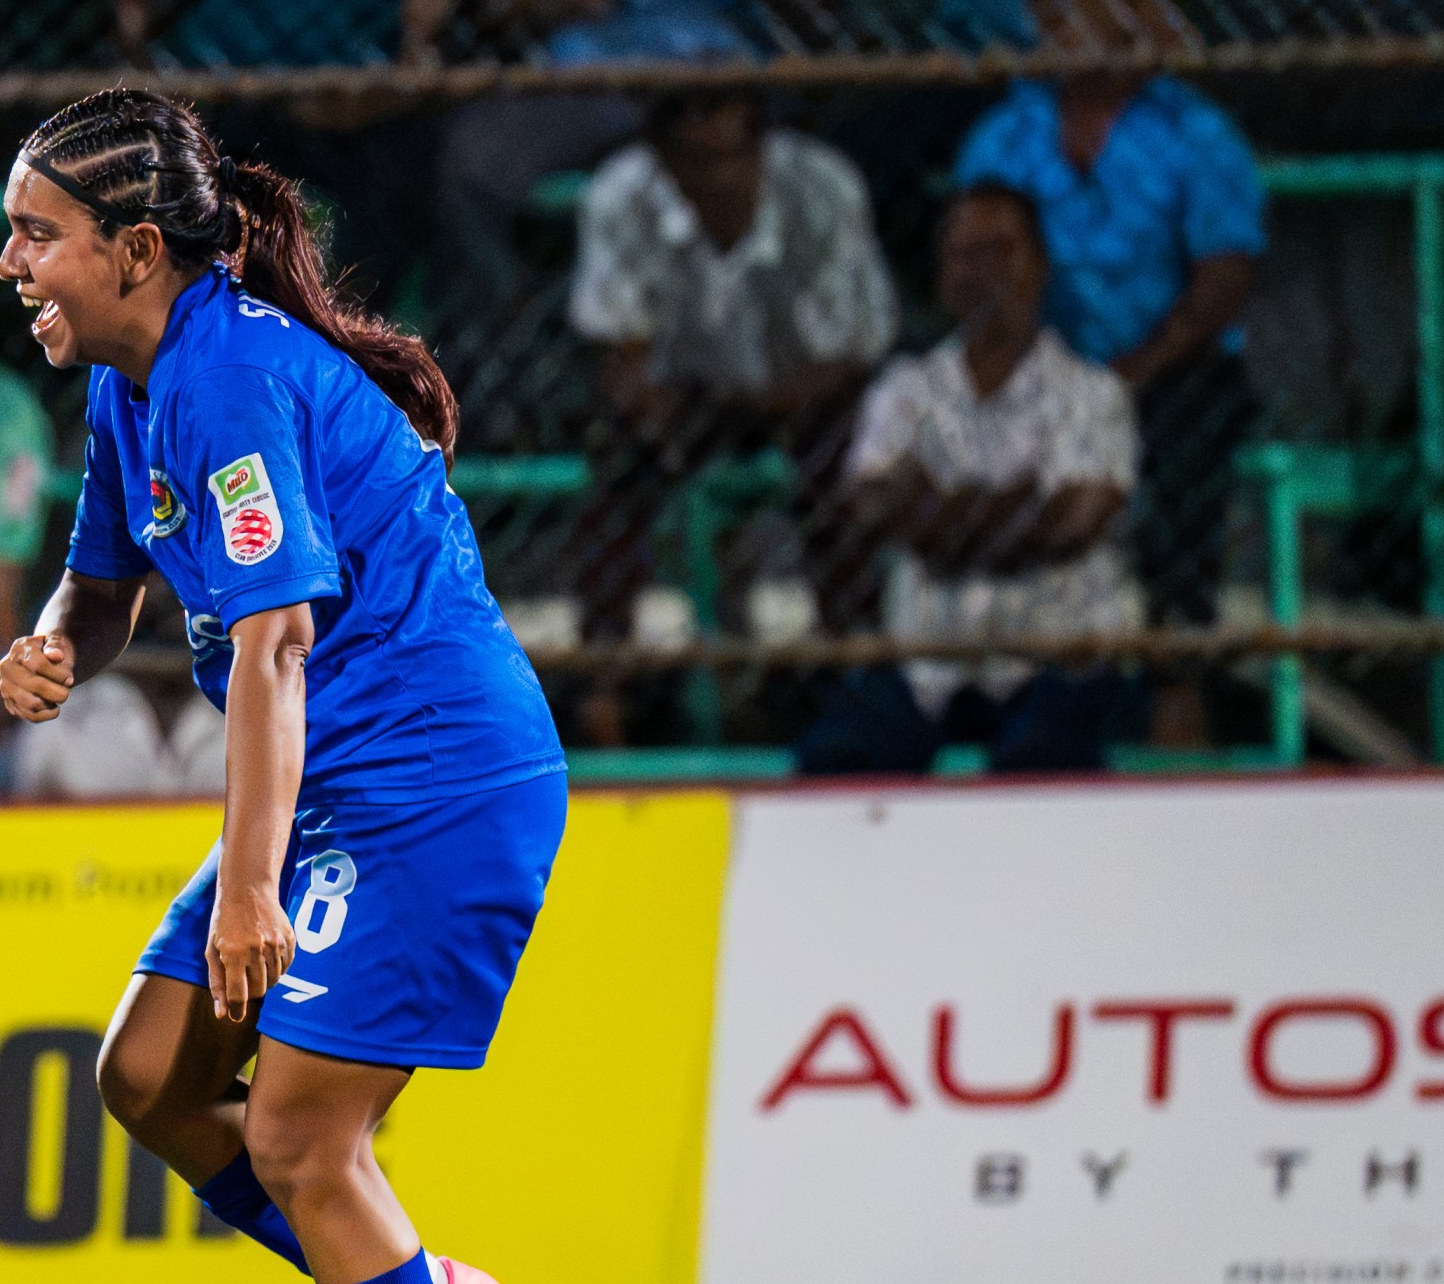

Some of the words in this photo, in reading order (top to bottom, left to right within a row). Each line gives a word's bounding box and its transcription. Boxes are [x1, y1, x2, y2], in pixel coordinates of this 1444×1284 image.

[227, 471, 248, 493] MILO
[294, 848, 358, 955] 8
[973, 1153, 1128, 1204] BY
